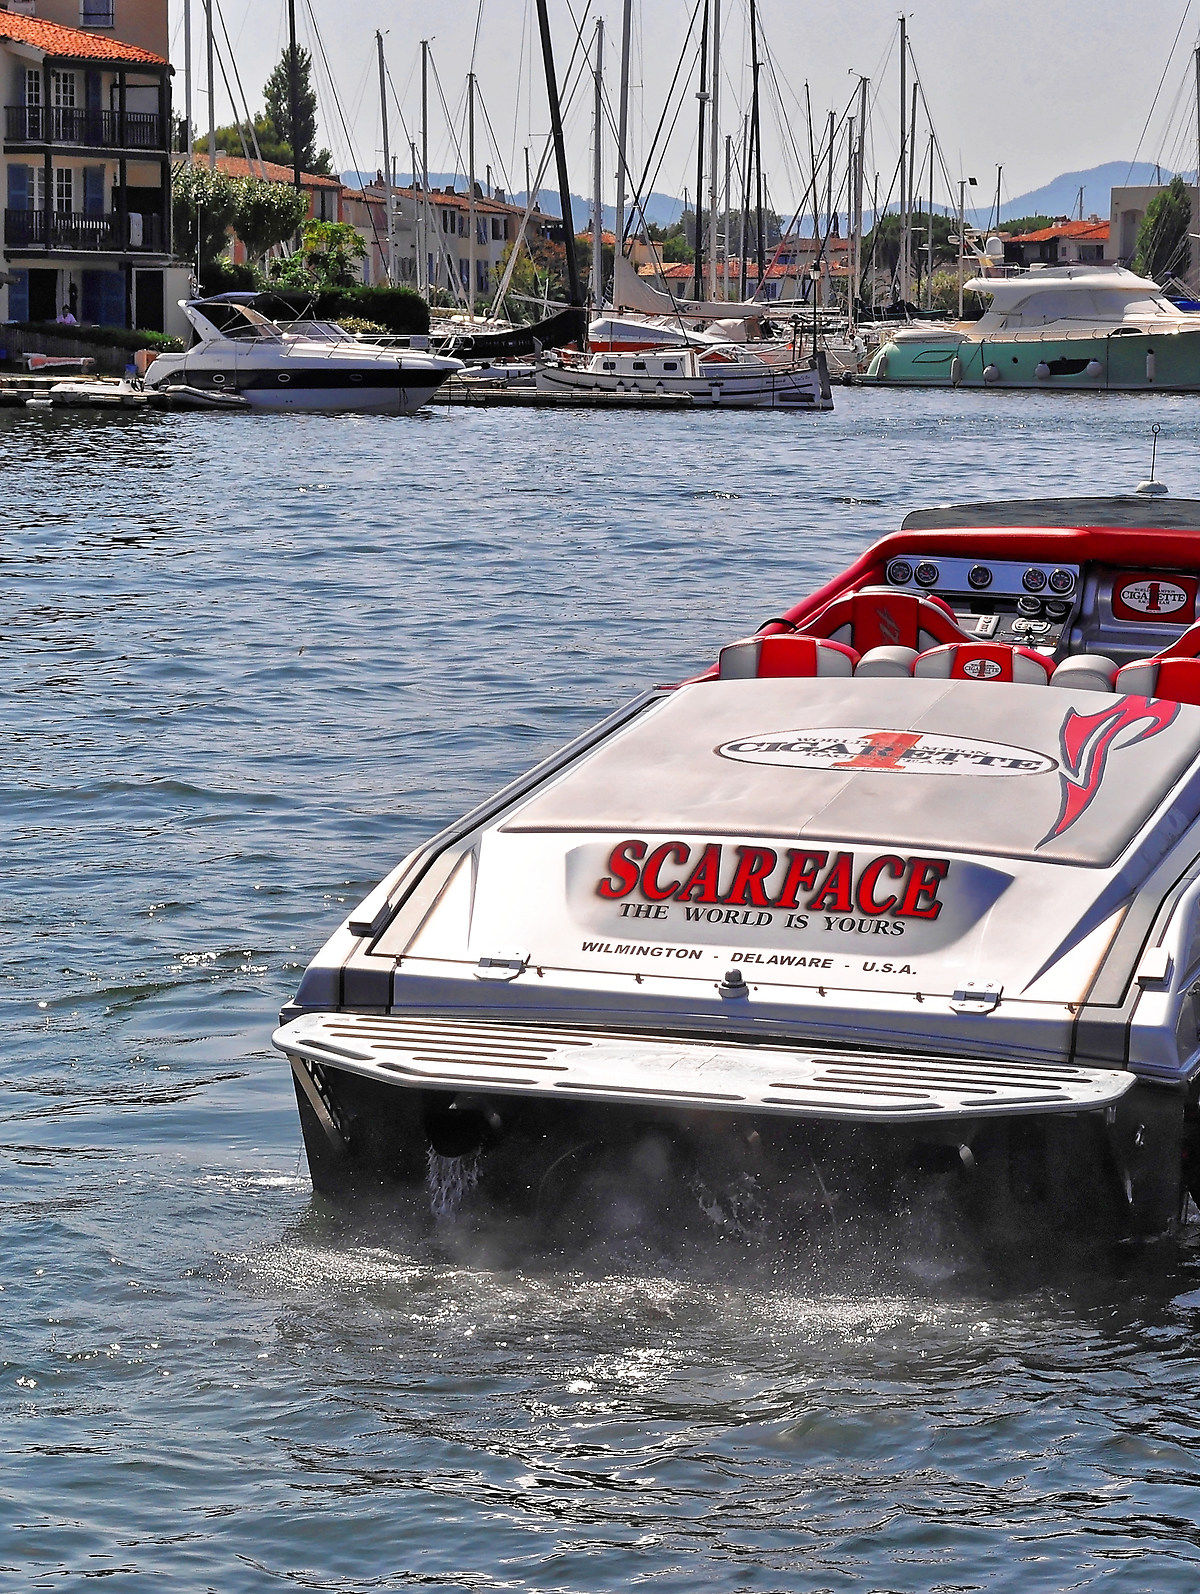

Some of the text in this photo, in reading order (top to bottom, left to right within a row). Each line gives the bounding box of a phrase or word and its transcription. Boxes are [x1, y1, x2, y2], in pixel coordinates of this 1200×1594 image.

[1122, 590, 1186, 602] CIGAETTE
[727, 741, 1044, 771] CIGARETTE
[599, 839, 951, 921] SCARFACE
[620, 902, 906, 936] THE WORLD IS YOURS
[581, 941, 703, 960] WILMINGTON
[730, 952, 834, 969] DELAWARE
[862, 961, 917, 975] U.S.A.
